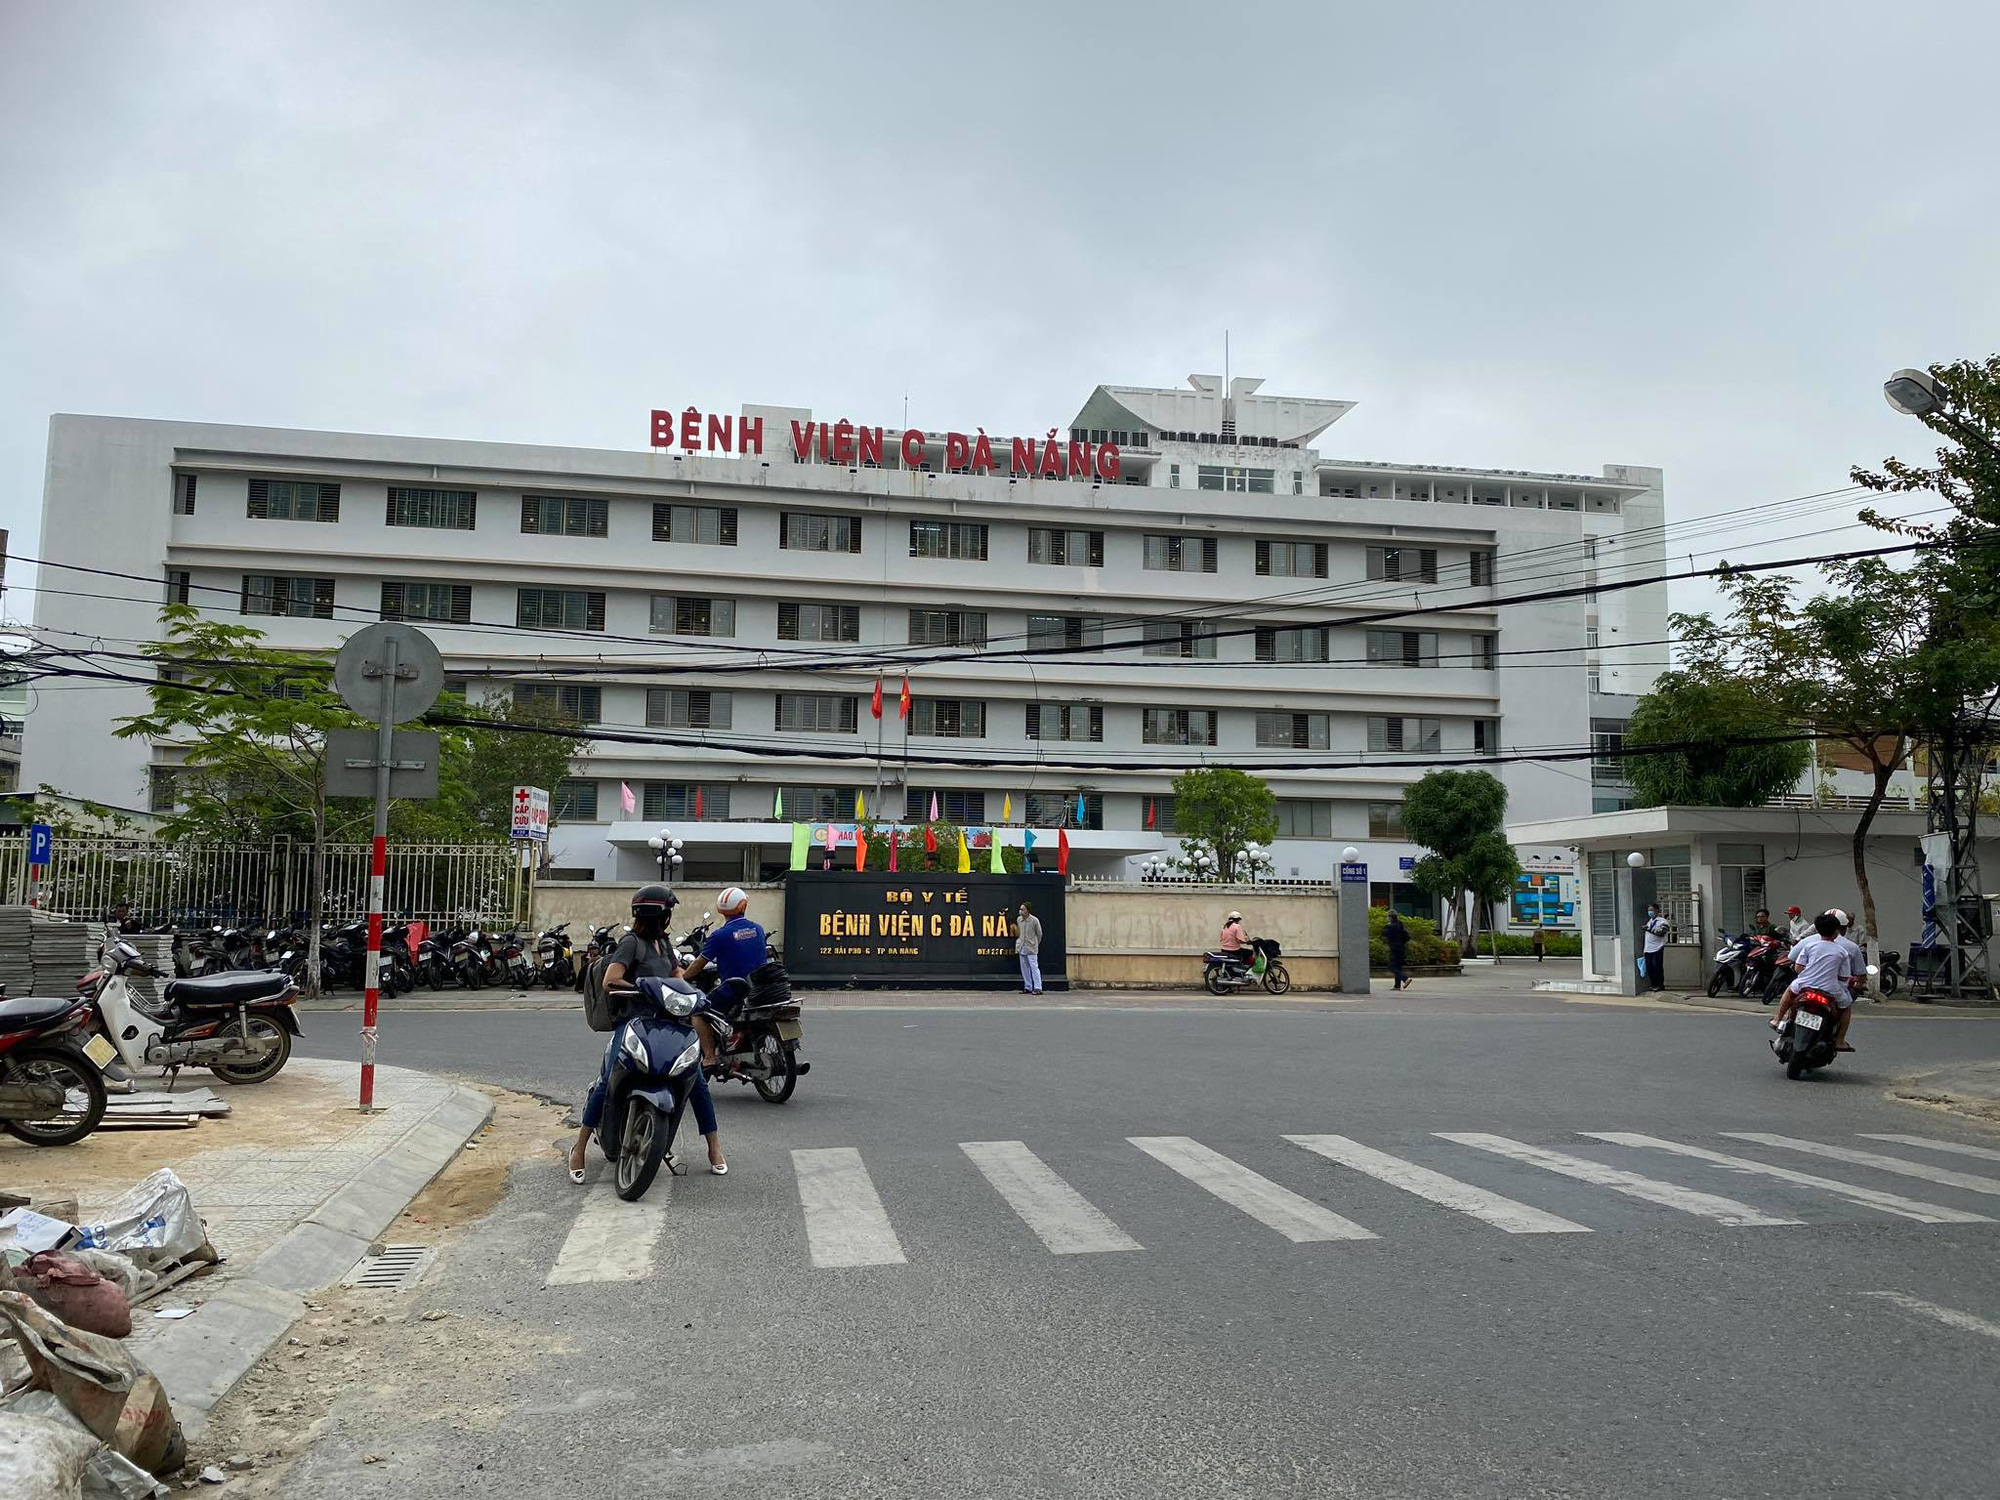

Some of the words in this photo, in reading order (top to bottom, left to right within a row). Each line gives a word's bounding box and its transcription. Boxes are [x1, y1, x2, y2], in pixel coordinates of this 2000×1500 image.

[650, 406, 763, 455] BỆNH
[790, 418, 883, 466] VIỆN
[901, 429, 926, 466] C
[946, 427, 996, 470] ĐÀ
[36, 833, 46, 855] P
[886, 888, 913, 905] BỘ
[921, 892, 934, 903] Y
[942, 887, 968, 904] TẾ
[820, 909, 870, 940] BỆNH
[878, 910, 924, 941] VIỆN
[931, 914, 942, 937] C
[950, 911, 975, 937] ĐÀ
